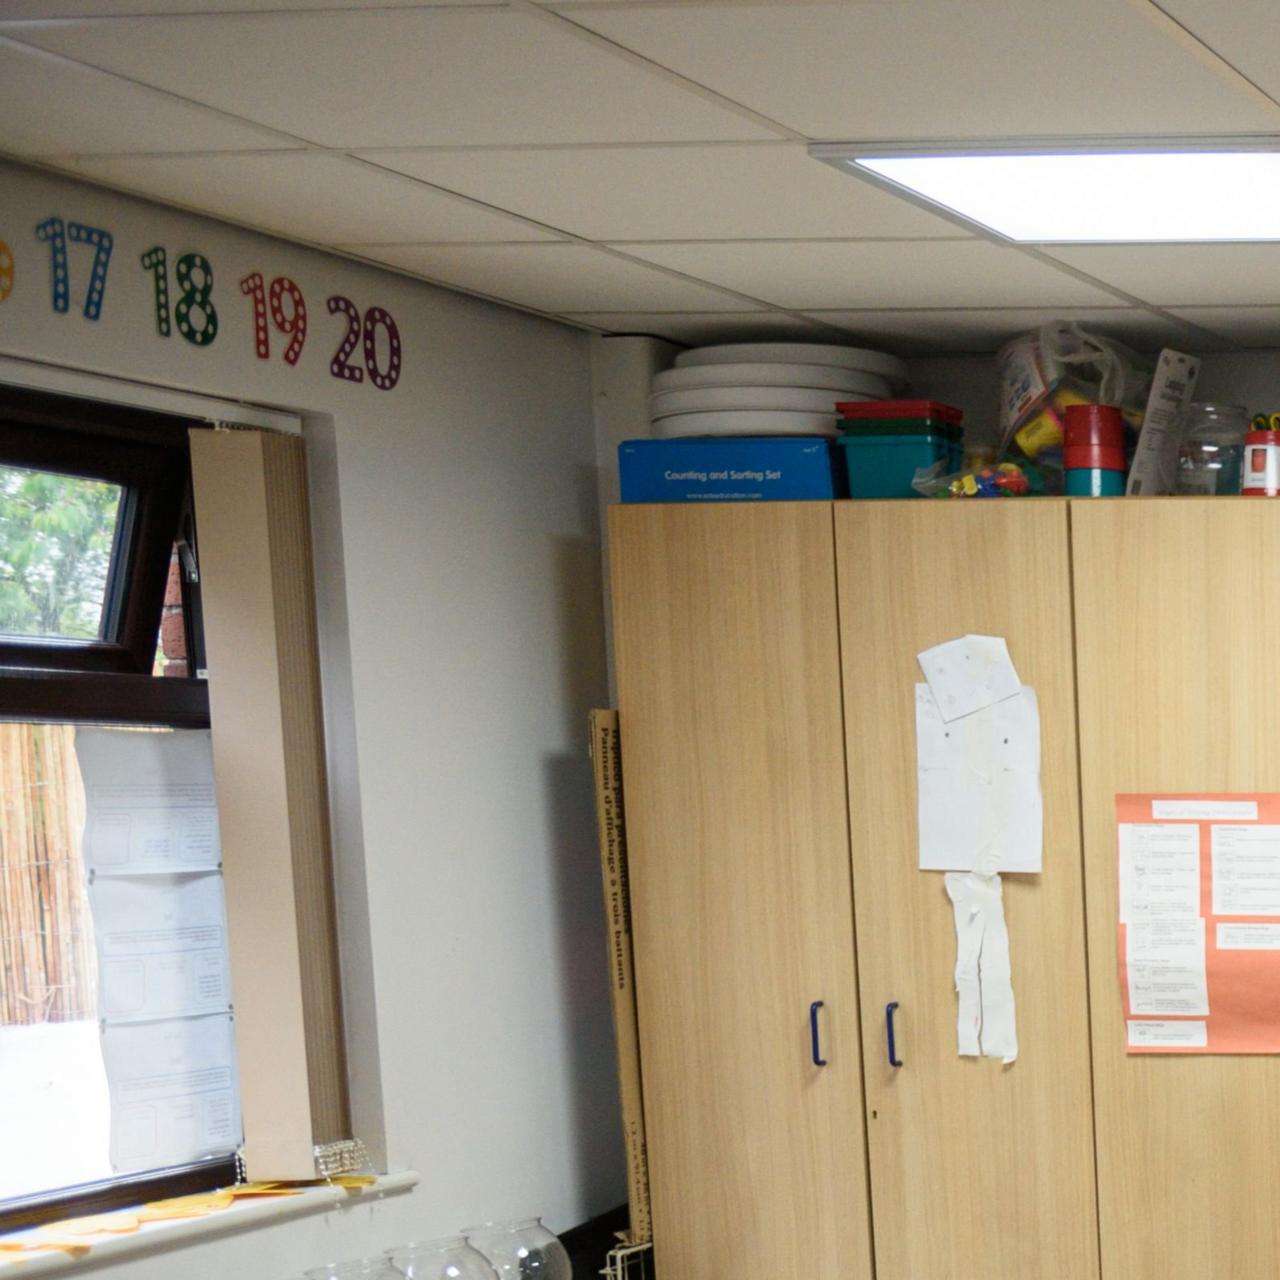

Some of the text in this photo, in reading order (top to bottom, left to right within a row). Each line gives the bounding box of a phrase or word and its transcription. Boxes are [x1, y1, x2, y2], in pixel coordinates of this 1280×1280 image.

[36, 217, 113, 320] 17
[141, 247, 218, 346] 18
[240, 273, 308, 365] 19
[327, 296, 401, 390] 20
[664, 470, 782, 482] Counting and Sorting Set
